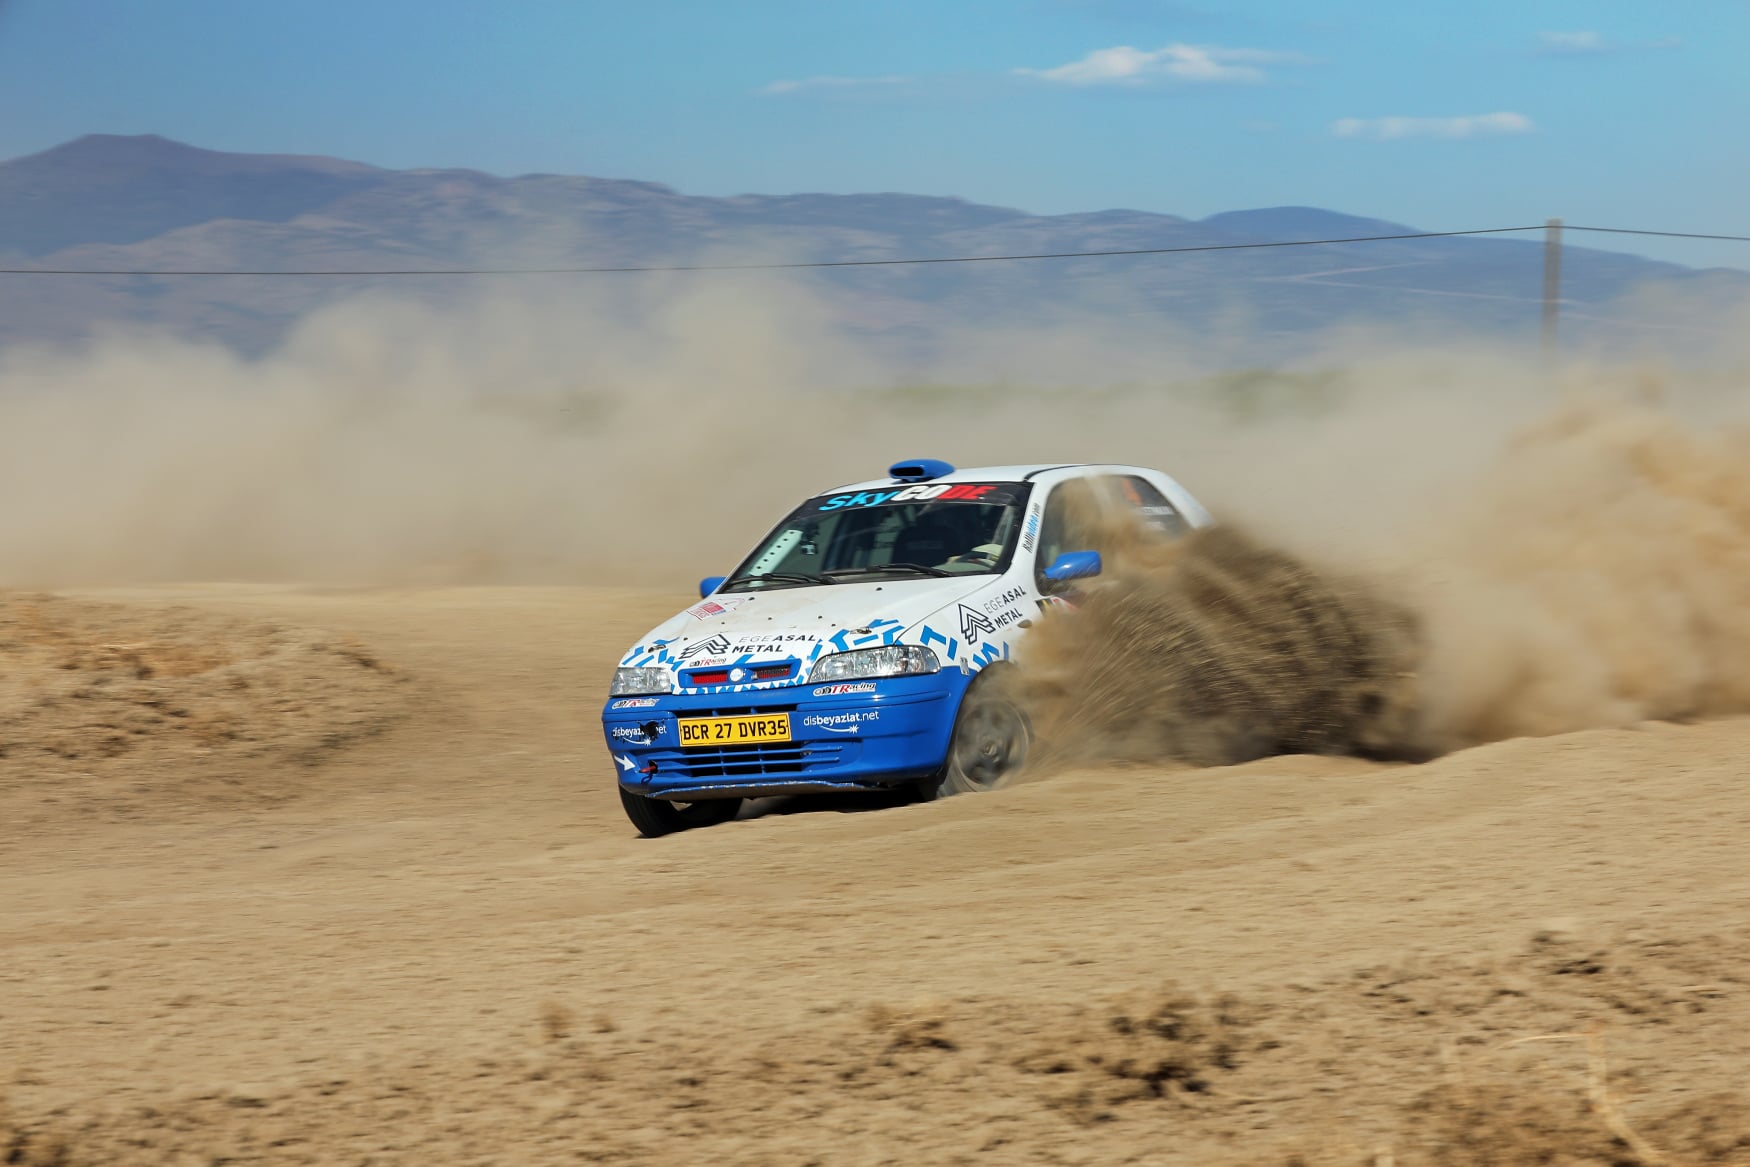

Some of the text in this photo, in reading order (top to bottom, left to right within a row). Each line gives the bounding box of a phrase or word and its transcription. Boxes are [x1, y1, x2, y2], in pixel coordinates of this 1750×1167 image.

[984, 585, 1026, 613] EGEASAL
[994, 608, 1023, 628] METAL
[739, 634, 816, 643] EGEASAL
[732, 644, 784, 653] METAL
[803, 711, 880, 728] disbeyazlat.net
[683, 720, 787, 740] BCR 27 DVR35
